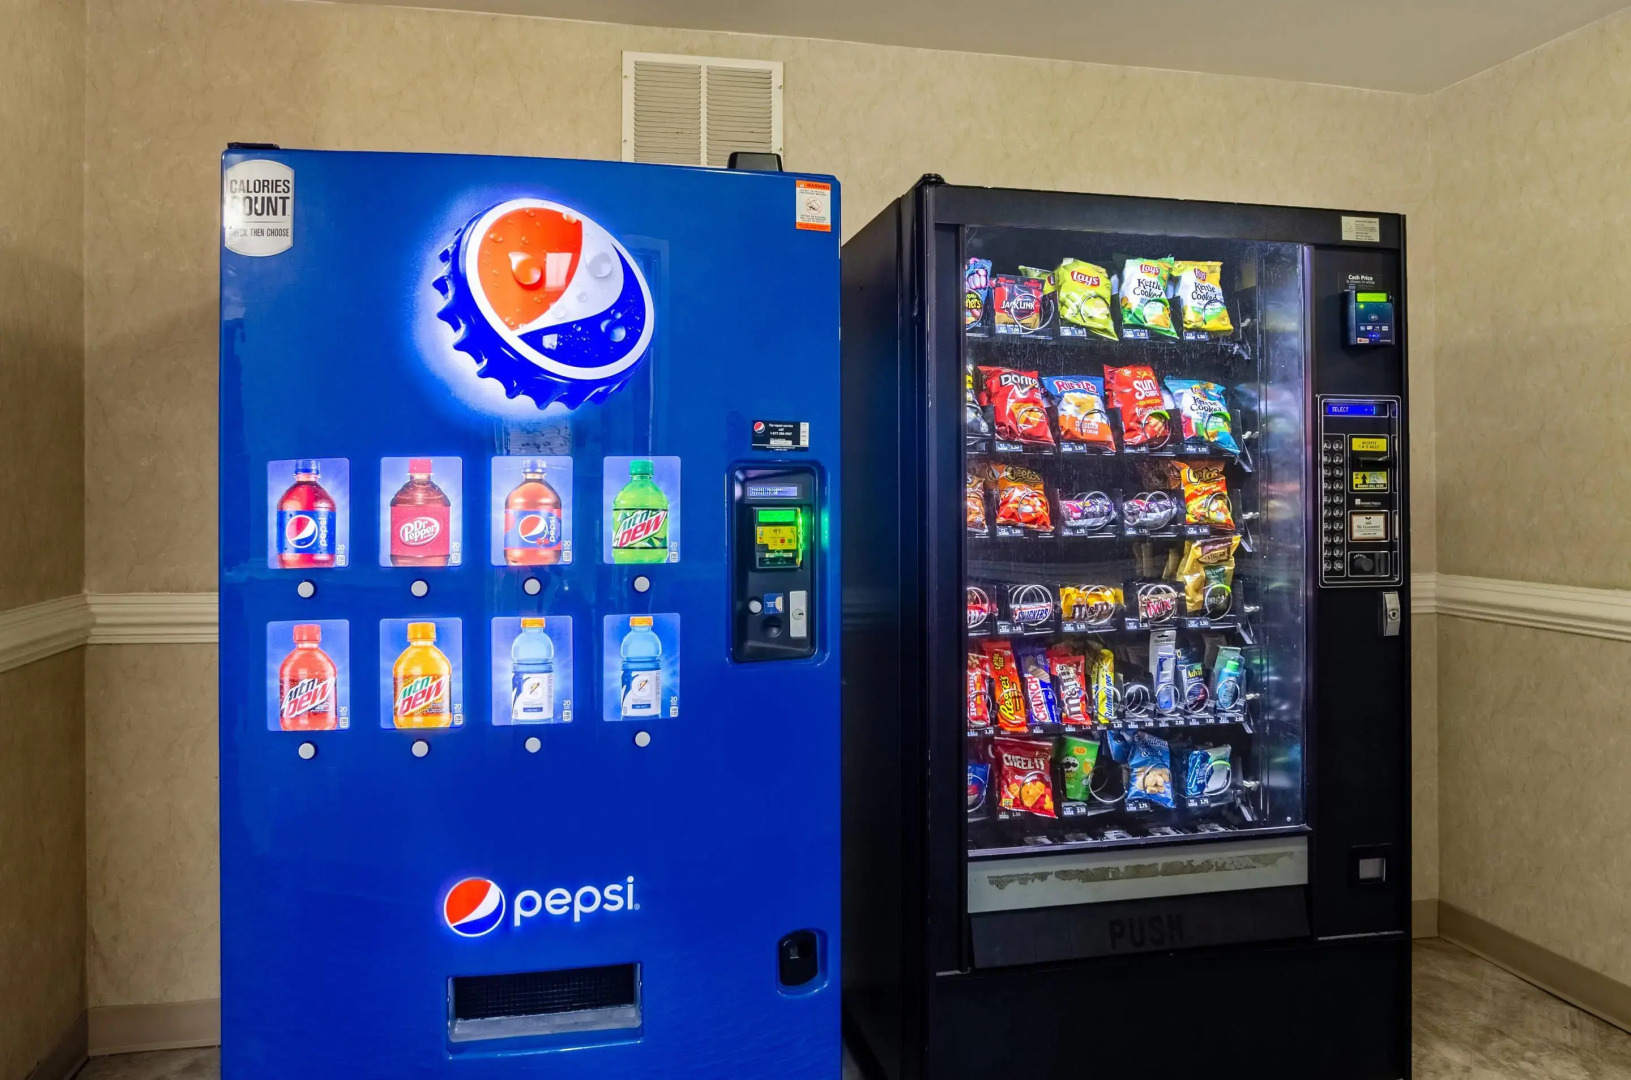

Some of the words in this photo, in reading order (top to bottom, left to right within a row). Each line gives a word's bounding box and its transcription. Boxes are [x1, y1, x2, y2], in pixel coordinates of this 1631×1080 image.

[230, 179, 290, 194] CALORIES
[250, 228, 265, 237] THEN
[266, 228, 290, 238] CHOOSE
[318, 517, 328, 546] pepsi
[404, 523, 438, 542] Pepper
[413, 520, 428, 530] Dr
[1104, 674, 1113, 718] Butterfiger
[514, 875, 635, 927] pepsi
[1108, 913, 1184, 950] PUSH
